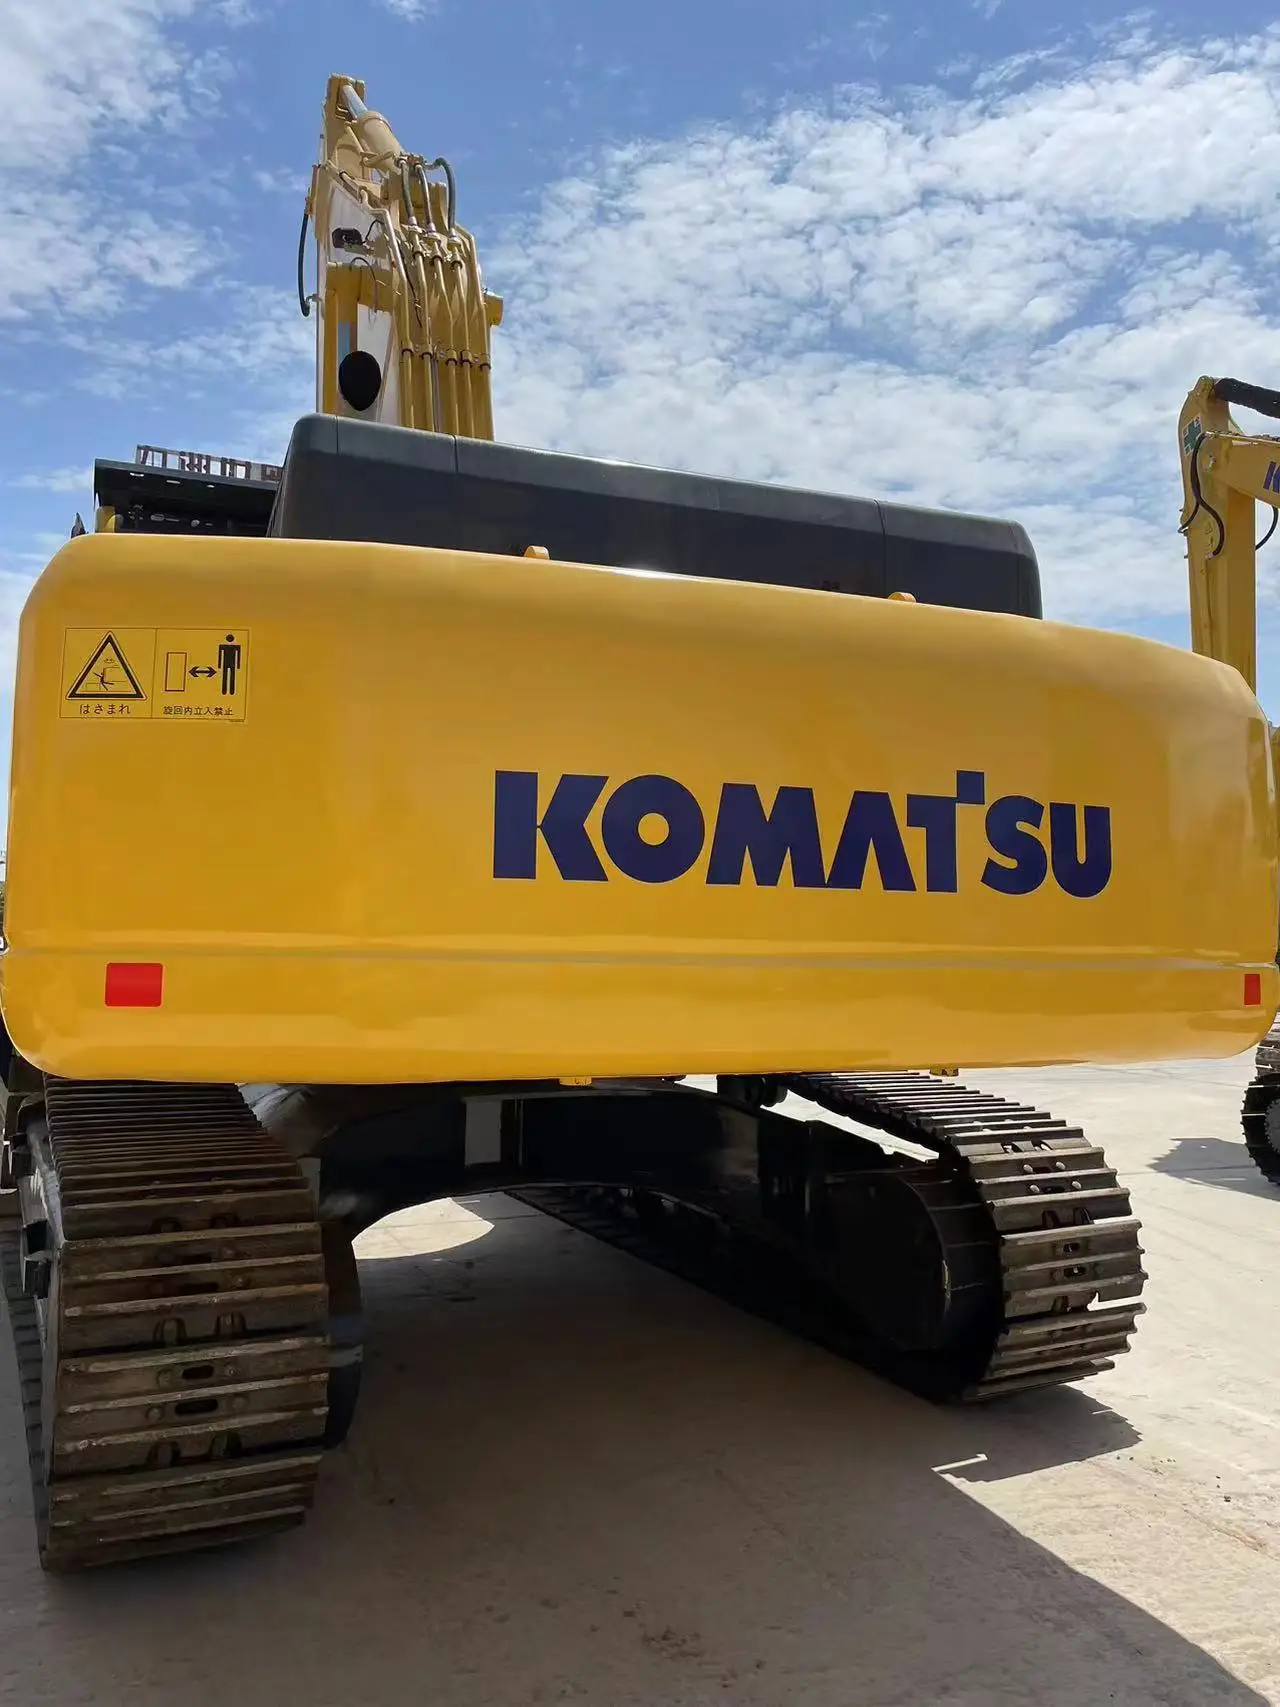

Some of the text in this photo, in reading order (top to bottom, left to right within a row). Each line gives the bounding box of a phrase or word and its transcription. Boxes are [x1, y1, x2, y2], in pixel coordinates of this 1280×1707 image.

[79, 703, 131, 715] はさまれ
[163, 705, 233, 716] 旋回内立入禁止
[493, 769, 1113, 899] KOMATSU
